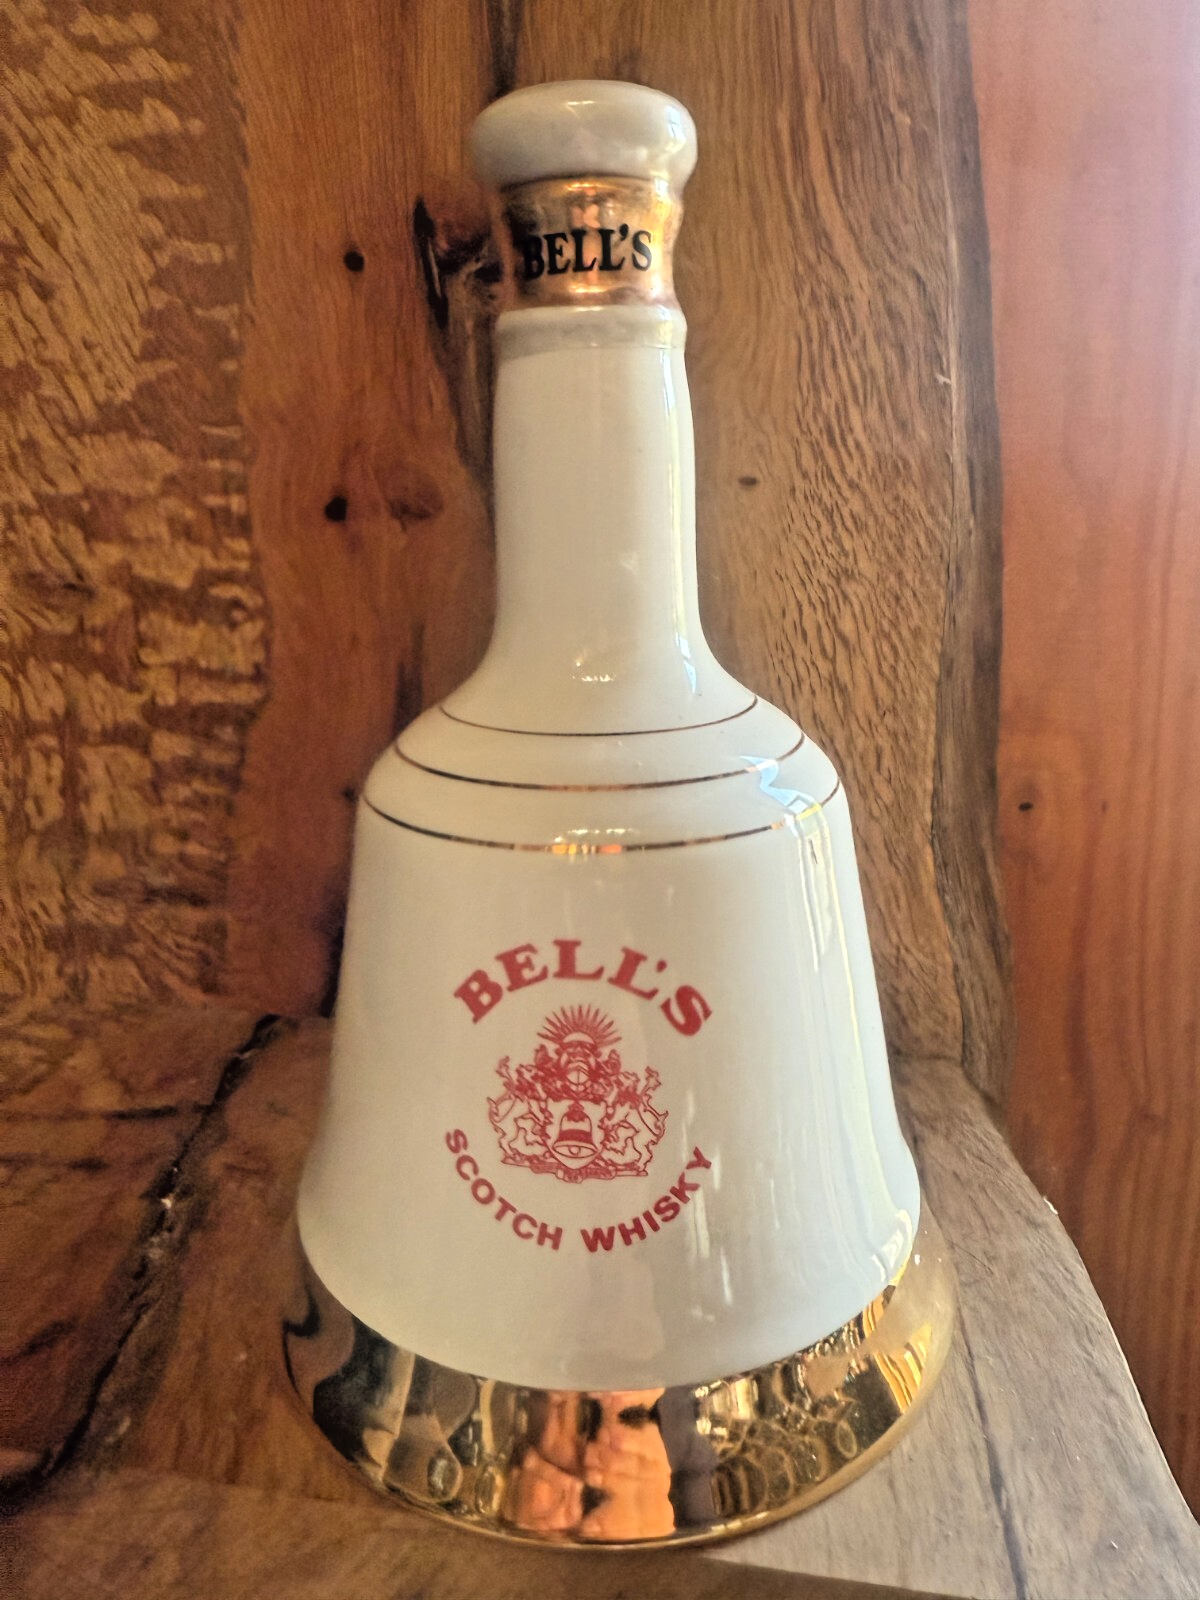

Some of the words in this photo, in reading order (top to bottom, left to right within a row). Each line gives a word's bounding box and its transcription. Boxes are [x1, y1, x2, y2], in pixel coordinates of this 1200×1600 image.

[523, 223, 652, 280] BELL'S
[453, 939, 712, 1037] BELL'S
[445, 1129, 564, 1251] SCOTCH
[580, 1146, 712, 1254] WHISKY
